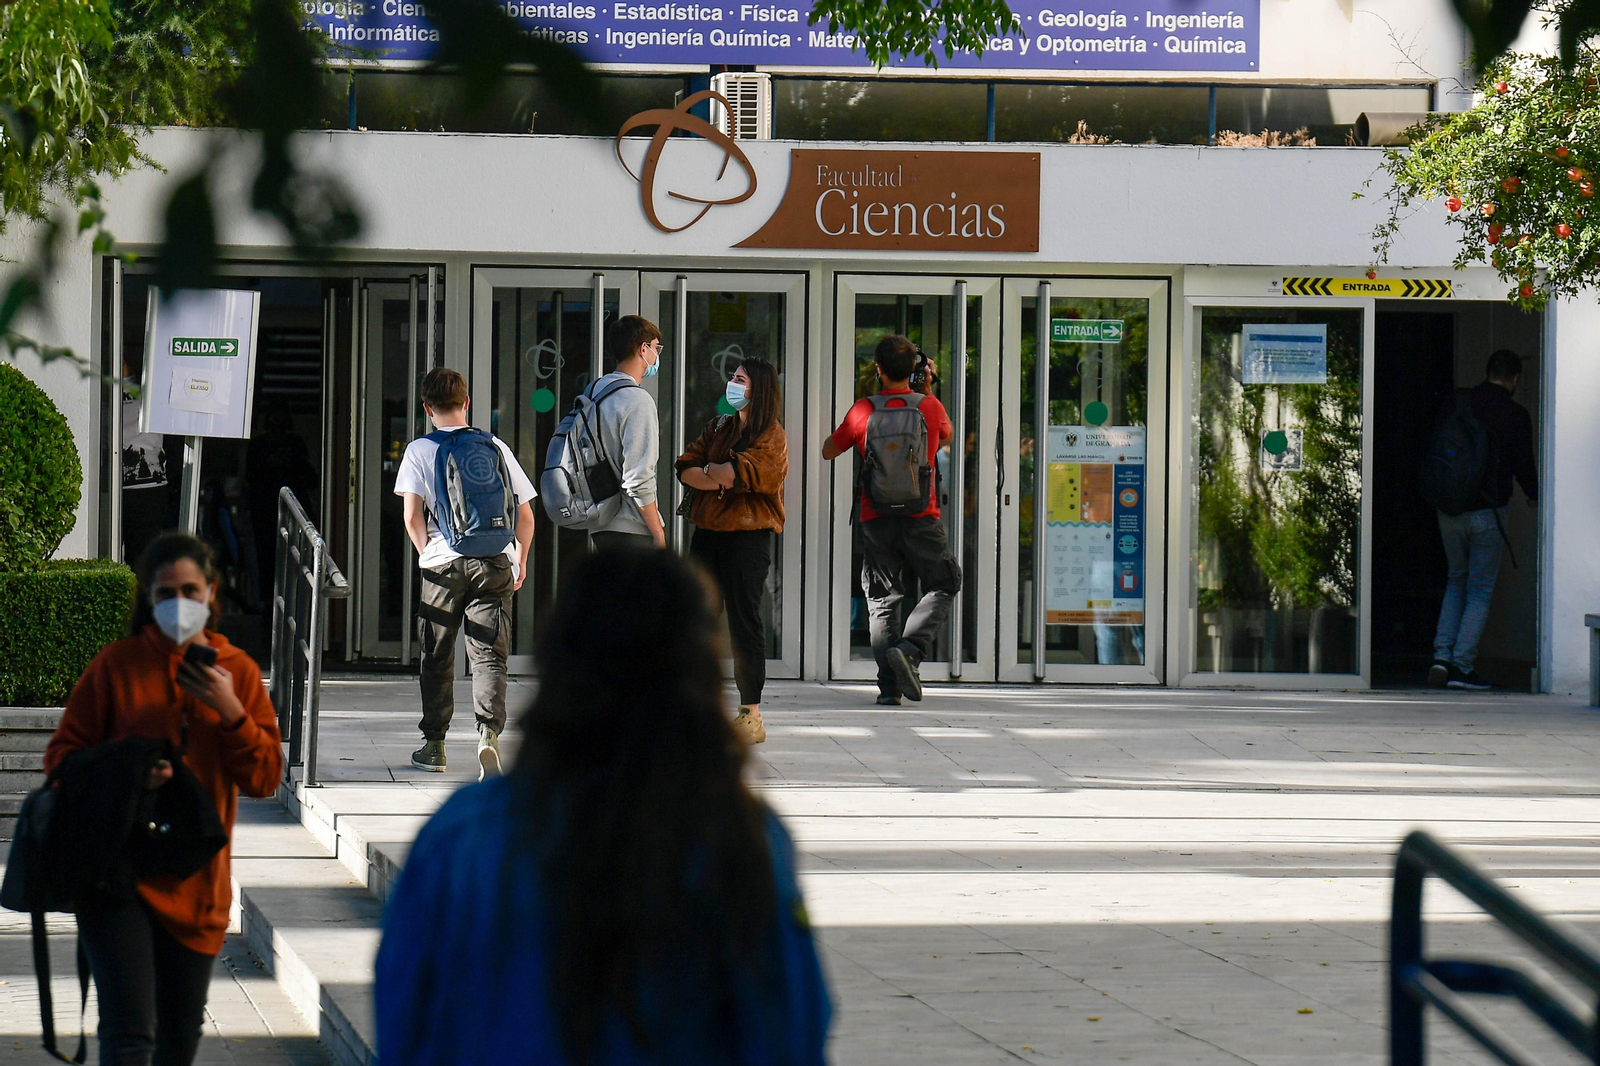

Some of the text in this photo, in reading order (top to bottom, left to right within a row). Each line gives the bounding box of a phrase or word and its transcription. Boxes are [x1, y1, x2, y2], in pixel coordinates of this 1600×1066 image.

[382, 0, 432, 17] Cien
[497, 1, 596, 19] bientales
[614, 3, 723, 20] Estadística
[740, 4, 799, 22] Física
[1038, 9, 1127, 32] Geología
[1146, 11, 1245, 32] Ingeniería
[329, 23, 440, 41] Informática
[606, 28, 704, 49] Ingeniería
[709, 29, 791, 48] Química
[1018, 38, 1031, 55] y
[1036, 34, 1147, 55] Optometría
[1164, 35, 1247, 54] Química
[816, 164, 903, 188] Facultad
[815, 188, 1007, 239] Ciencias
[1342, 283, 1391, 292] ENTRADA
[1054, 325, 1100, 336] ENTRADA
[174, 341, 217, 353] SALIDA
